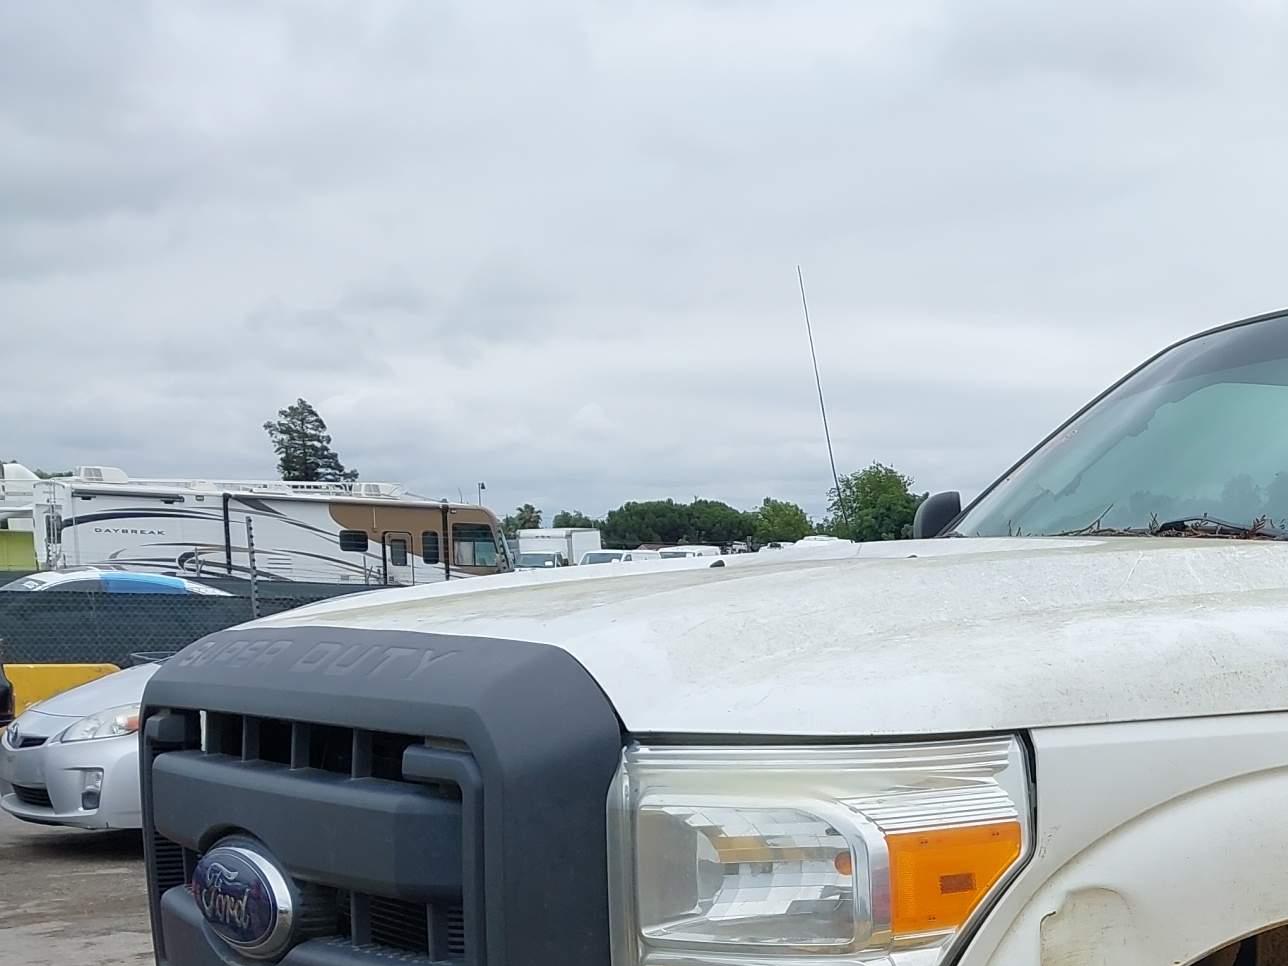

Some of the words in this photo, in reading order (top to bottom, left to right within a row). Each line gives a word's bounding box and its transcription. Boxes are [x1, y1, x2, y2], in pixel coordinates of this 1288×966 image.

[94, 527, 167, 536] DAYBREAK
[177, 639, 293, 668] SUPER
[289, 641, 457, 681] DUTY
[201, 862, 251, 929] Ford
